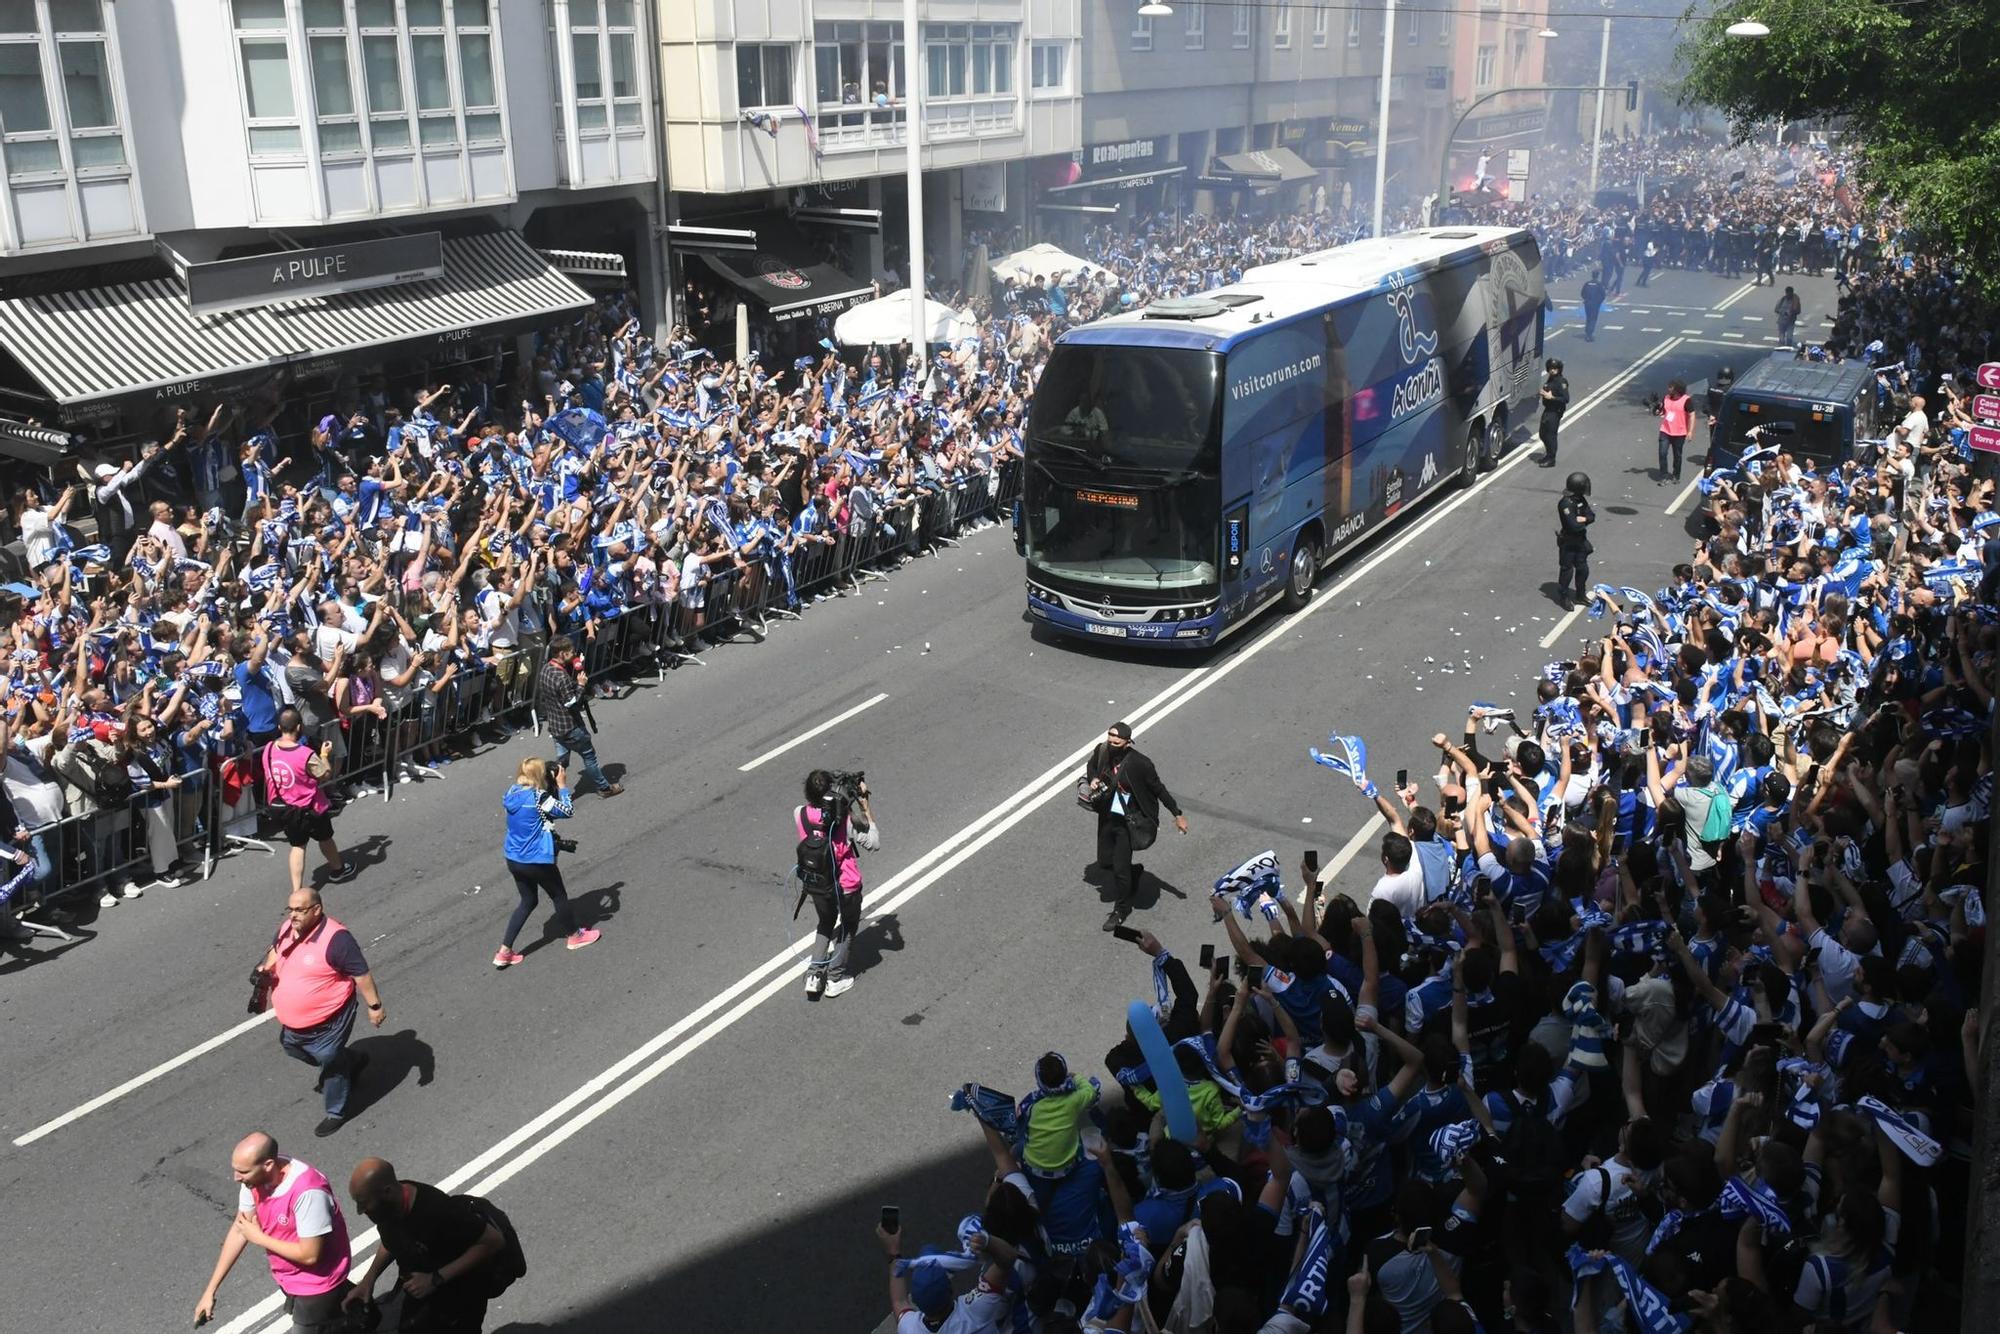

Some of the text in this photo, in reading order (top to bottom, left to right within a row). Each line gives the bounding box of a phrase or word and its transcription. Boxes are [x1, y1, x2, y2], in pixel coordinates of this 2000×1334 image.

[289, 254, 348, 280] PULPE
[816, 300, 845, 314] TABERNA
[446, 328, 472, 342] PULPE
[1231, 354, 1321, 400] visitcoruna.com
[166, 380, 200, 397] PULPE
[1979, 398, 1999, 409] Casa
[1978, 406, 1998, 417] Casa
[1974, 433, 1995, 445] Torre
[1332, 512, 1365, 546] ABANCA
[1230, 522, 1239, 552] DEPOR
